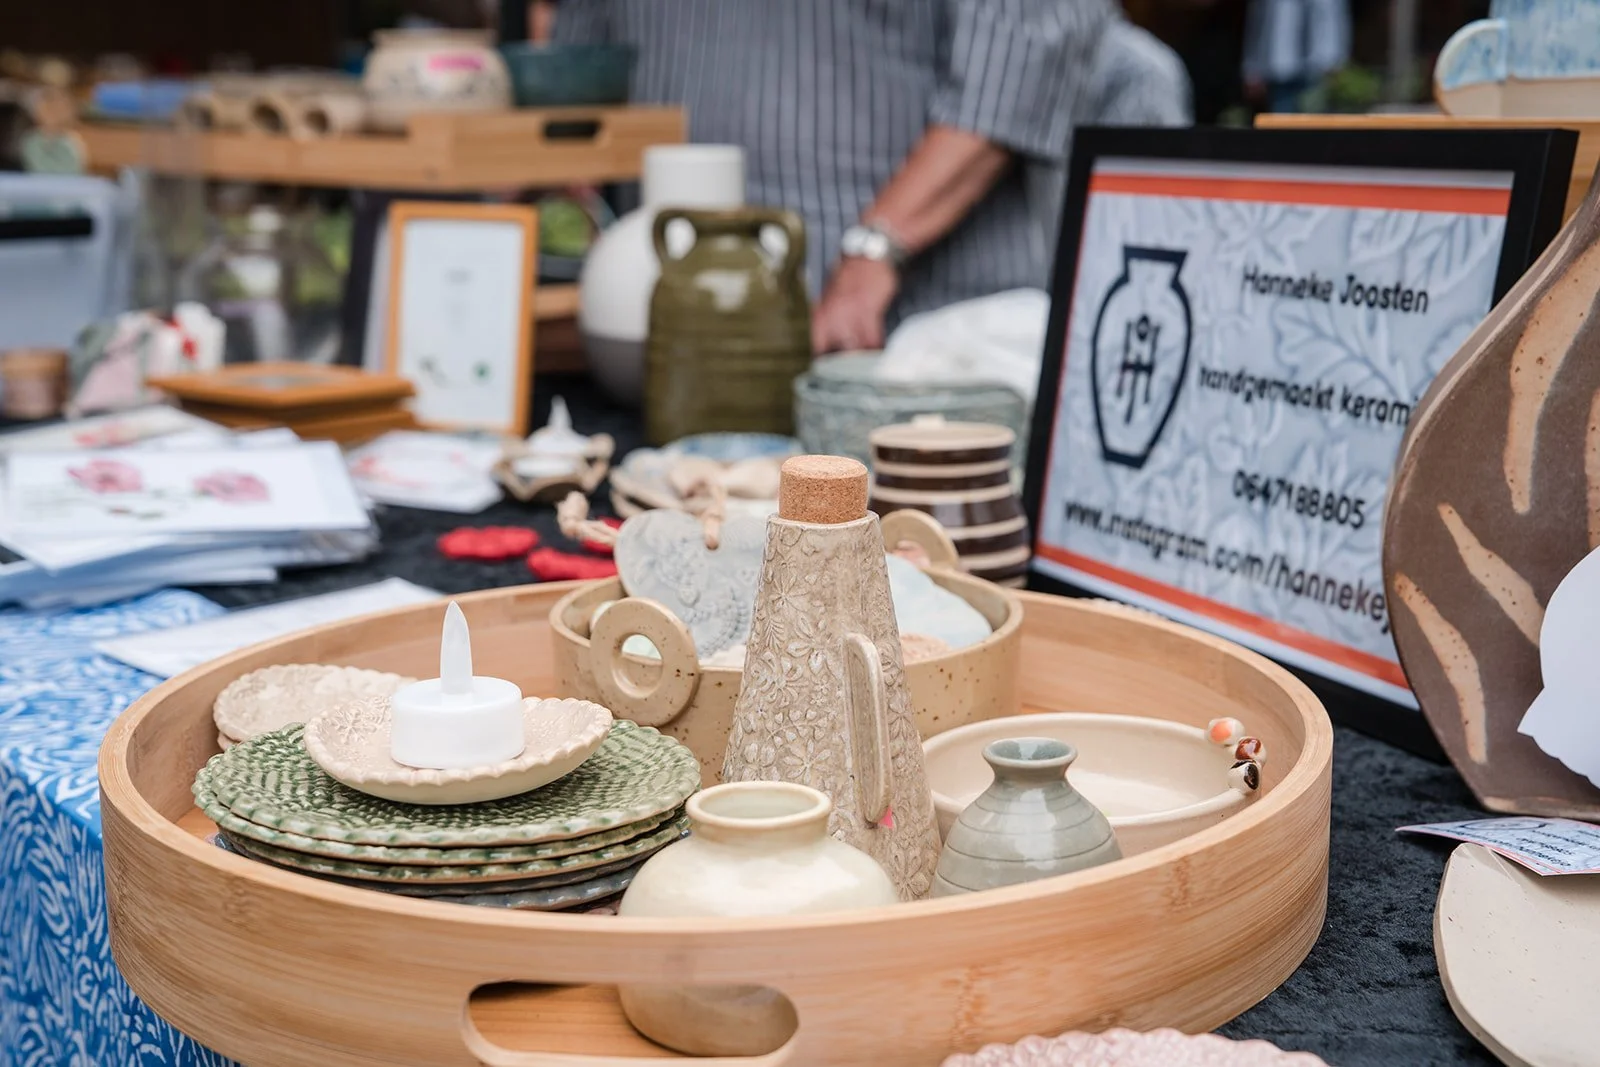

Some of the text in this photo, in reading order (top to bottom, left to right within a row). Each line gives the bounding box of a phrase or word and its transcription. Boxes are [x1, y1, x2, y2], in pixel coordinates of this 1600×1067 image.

[1241, 265, 1429, 314] Hanneke Joosten
[1199, 363, 1418, 426] handgemaakt keram
[1232, 469, 1366, 530] 0647188805
